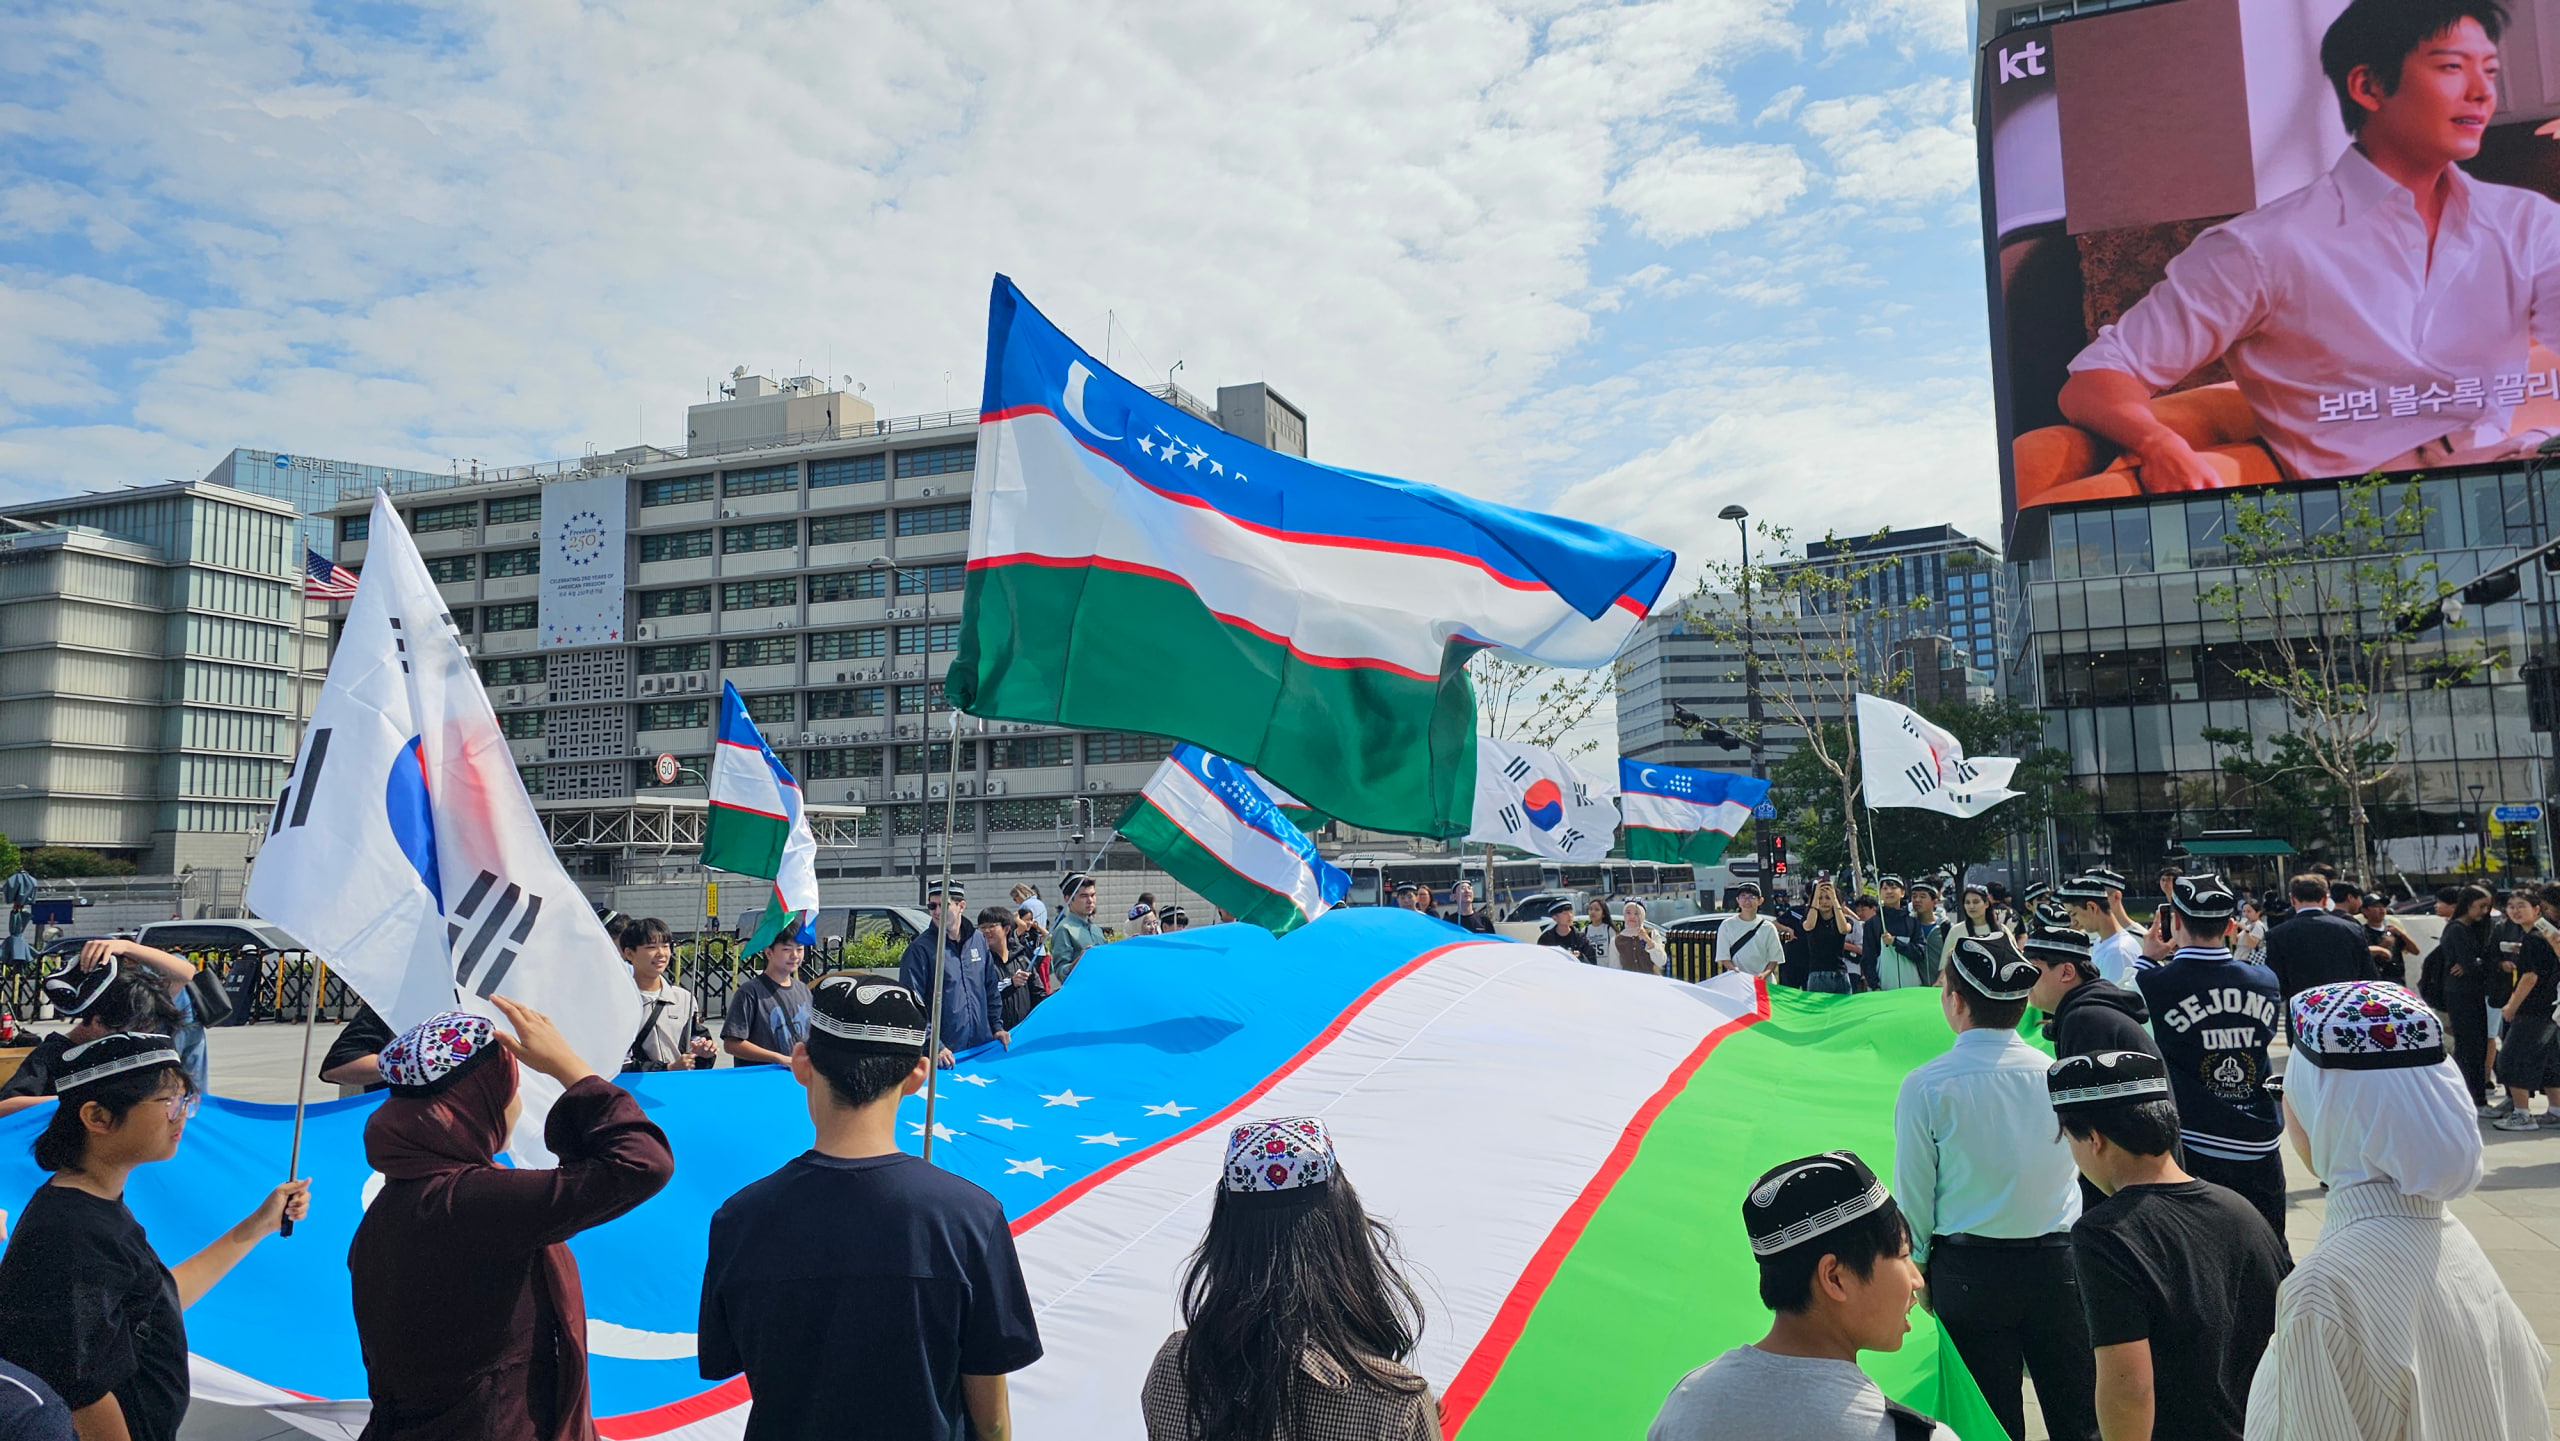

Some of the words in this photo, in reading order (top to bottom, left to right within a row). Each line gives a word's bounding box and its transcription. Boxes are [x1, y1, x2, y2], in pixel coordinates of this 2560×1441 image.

[1999, 41, 2045, 85] kt
[2317, 388, 2379, 423] 보면
[2387, 376, 2485, 418] 볼수록
[291, 457, 335, 473] 우리카드
[570, 528, 596, 536] Freedom
[569, 534, 596, 552] 250
[549, 576, 581, 584] CELEBRATING
[661, 761, 673, 775] 50
[2164, 988, 2275, 1033] SEJONG
[2201, 1027, 2261, 1050] UNIV.
